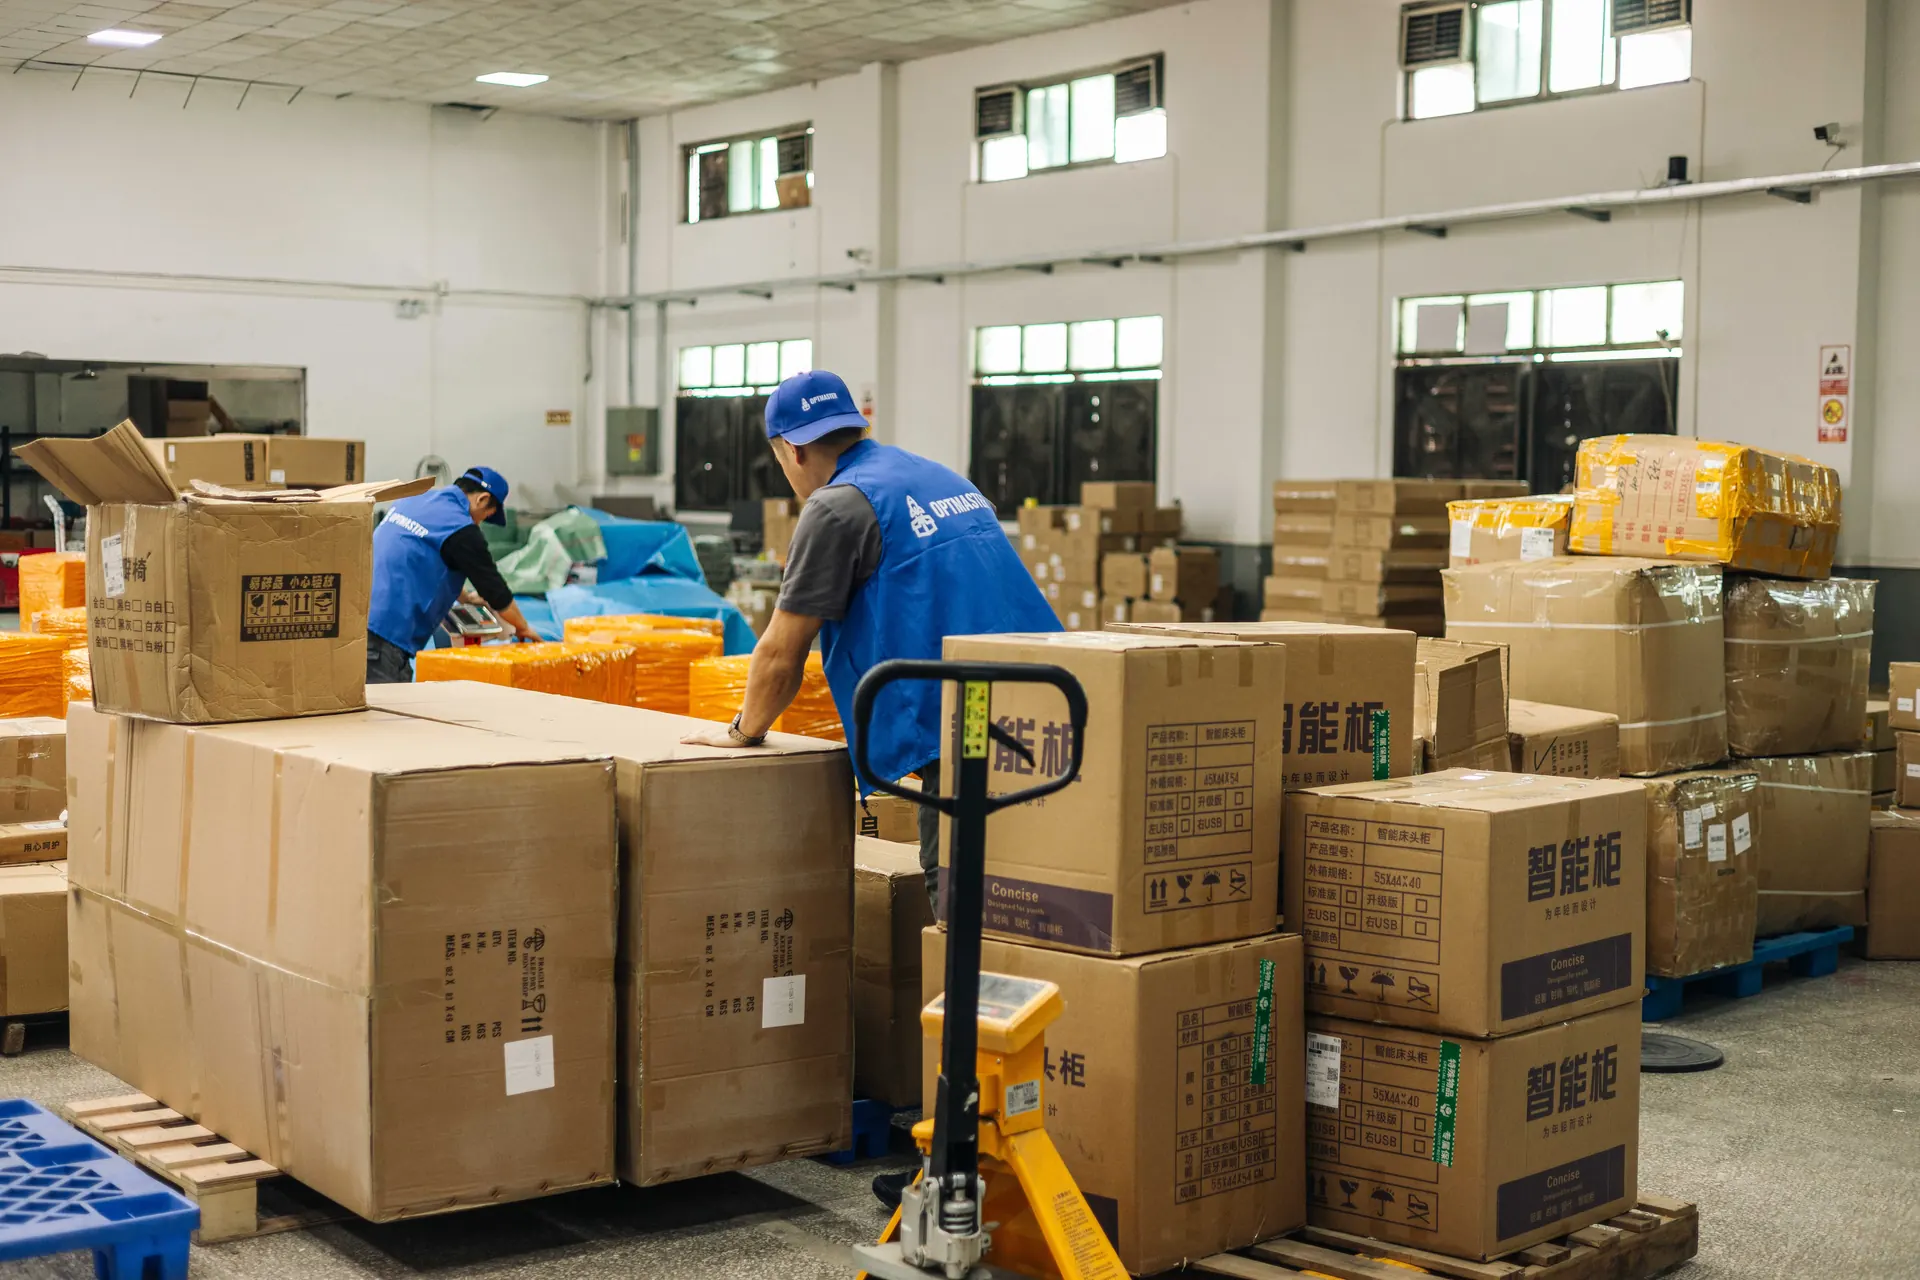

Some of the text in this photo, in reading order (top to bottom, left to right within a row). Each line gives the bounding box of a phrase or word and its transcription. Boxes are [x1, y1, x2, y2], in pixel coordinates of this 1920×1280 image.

[929, 492, 990, 518] OPTMASTE
[1283, 701, 1384, 754] 能柜
[1310, 820, 1431, 845] 产品名称： 智能床头柜
[1309, 842, 1354, 858] 产品型号：
[1308, 864, 1353, 880] 外箱规格：
[1528, 831, 1622, 902] 智能柜
[992, 882, 1039, 903] Concise
[1307, 886, 1398, 908] 标准版 升级版
[760, 909, 769, 928] ITEM
[1307, 908, 1398, 930] 左USB 右USB
[1545, 898, 1597, 921] 为年轻而设计
[706, 915, 715, 940] MEAS:
[445, 935, 455, 961] MEAS:
[508, 929, 517, 949] ITEM
[747, 911, 755, 1012] QTY: PCS
[1550, 953, 1585, 971] Concise
[537, 956, 545, 990] FRAGILE
[492, 930, 502, 1037] QTY: PCS
[521, 977, 529, 997] DROP
[705, 1005, 714, 1017] CM
[720, 999, 728, 1015] KGS
[733, 997, 741, 1013] KGS
[445, 1030, 455, 1043] CM
[461, 1025, 471, 1041] KGS
[477, 1023, 486, 1040] KGS
[1375, 1044, 1429, 1064] 智能床头柜
[1526, 1044, 1618, 1122] 智能柜
[1366, 1109, 1397, 1125] 升级版
[1543, 1113, 1593, 1139] 为年轻而设计
[1240, 1134, 1259, 1149] USB
[1310, 1121, 1397, 1148] USB 右USB
[1547, 1169, 1580, 1188] Concise
